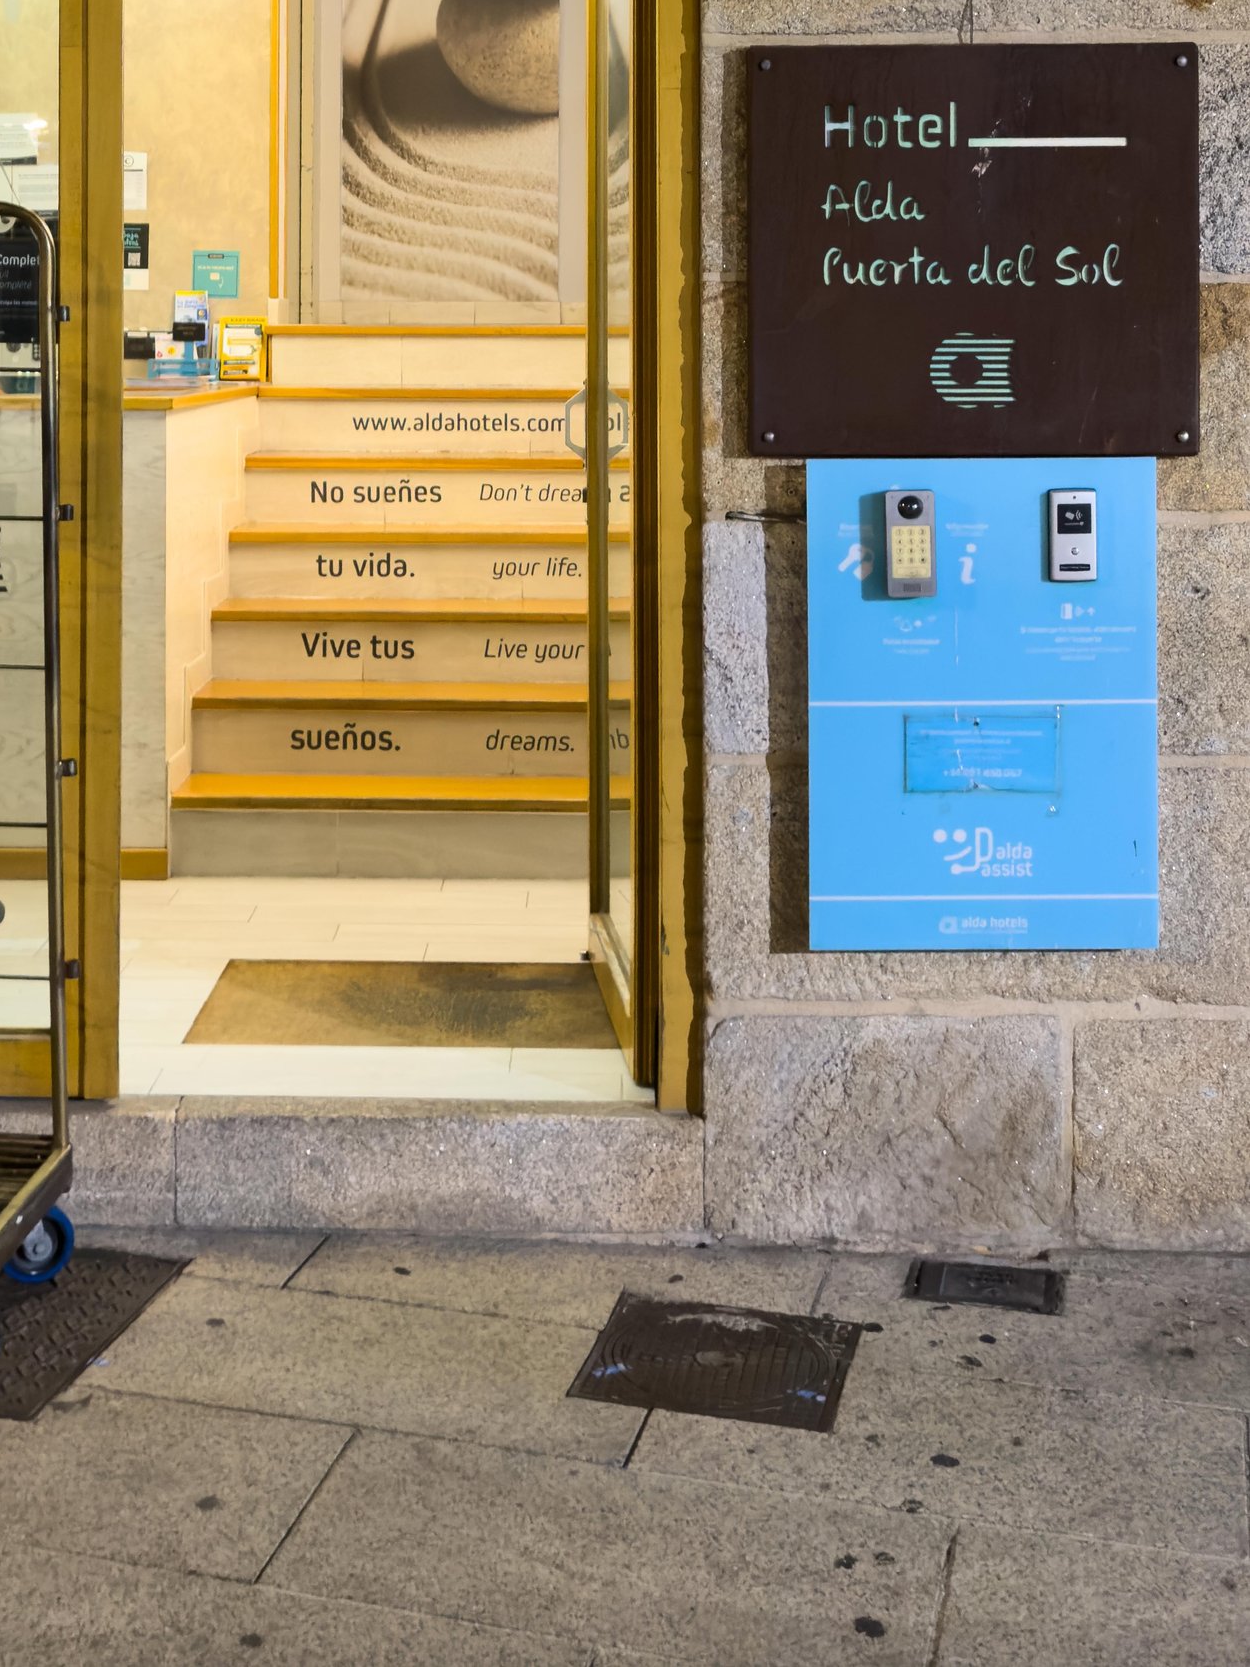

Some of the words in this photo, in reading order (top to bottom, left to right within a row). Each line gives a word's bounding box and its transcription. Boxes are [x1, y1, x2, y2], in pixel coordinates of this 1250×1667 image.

[824, 101, 957, 148] Hotel
[821, 180, 925, 223] Alda
[822, 246, 952, 287] Puerta
[968, 244, 1036, 287] del
[1055, 244, 1124, 287] Sol
[352, 412, 566, 433] www.aldahotels.com
[310, 481, 344, 503] No
[353, 479, 442, 503] sueñes
[479, 483, 532, 502] Don't
[538, 483, 583, 502] drea
[316, 554, 343, 578] tu
[353, 553, 415, 578] vida.
[492, 560, 540, 579] your
[545, 558, 582, 578] life.
[301, 633, 361, 658] Vive
[370, 636, 415, 659] tus
[483, 639, 528, 659] Live
[534, 643, 585, 663] your
[290, 723, 401, 751] sueños.
[485, 729, 575, 752] dreams.
[996, 842, 1032, 860] alda
[981, 860, 1033, 877] assist
